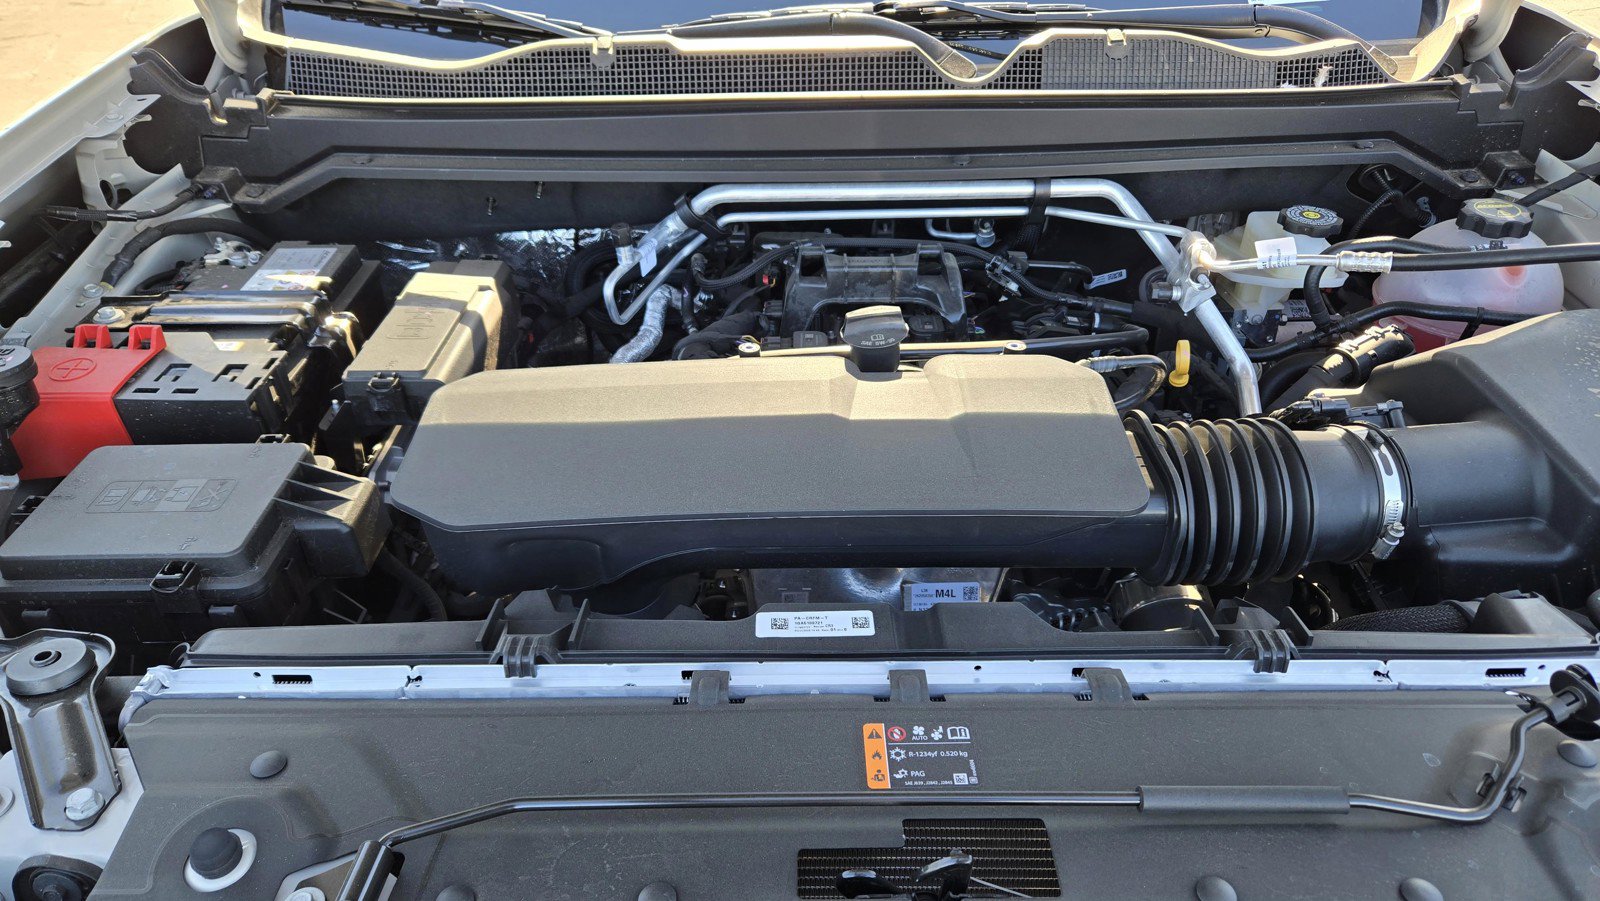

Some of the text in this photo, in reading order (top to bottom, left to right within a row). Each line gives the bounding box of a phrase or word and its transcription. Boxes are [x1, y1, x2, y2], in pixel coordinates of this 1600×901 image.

[935, 589, 956, 598] M4L
[908, 750, 937, 758] R-1234yf
[959, 750, 968, 758] kg
